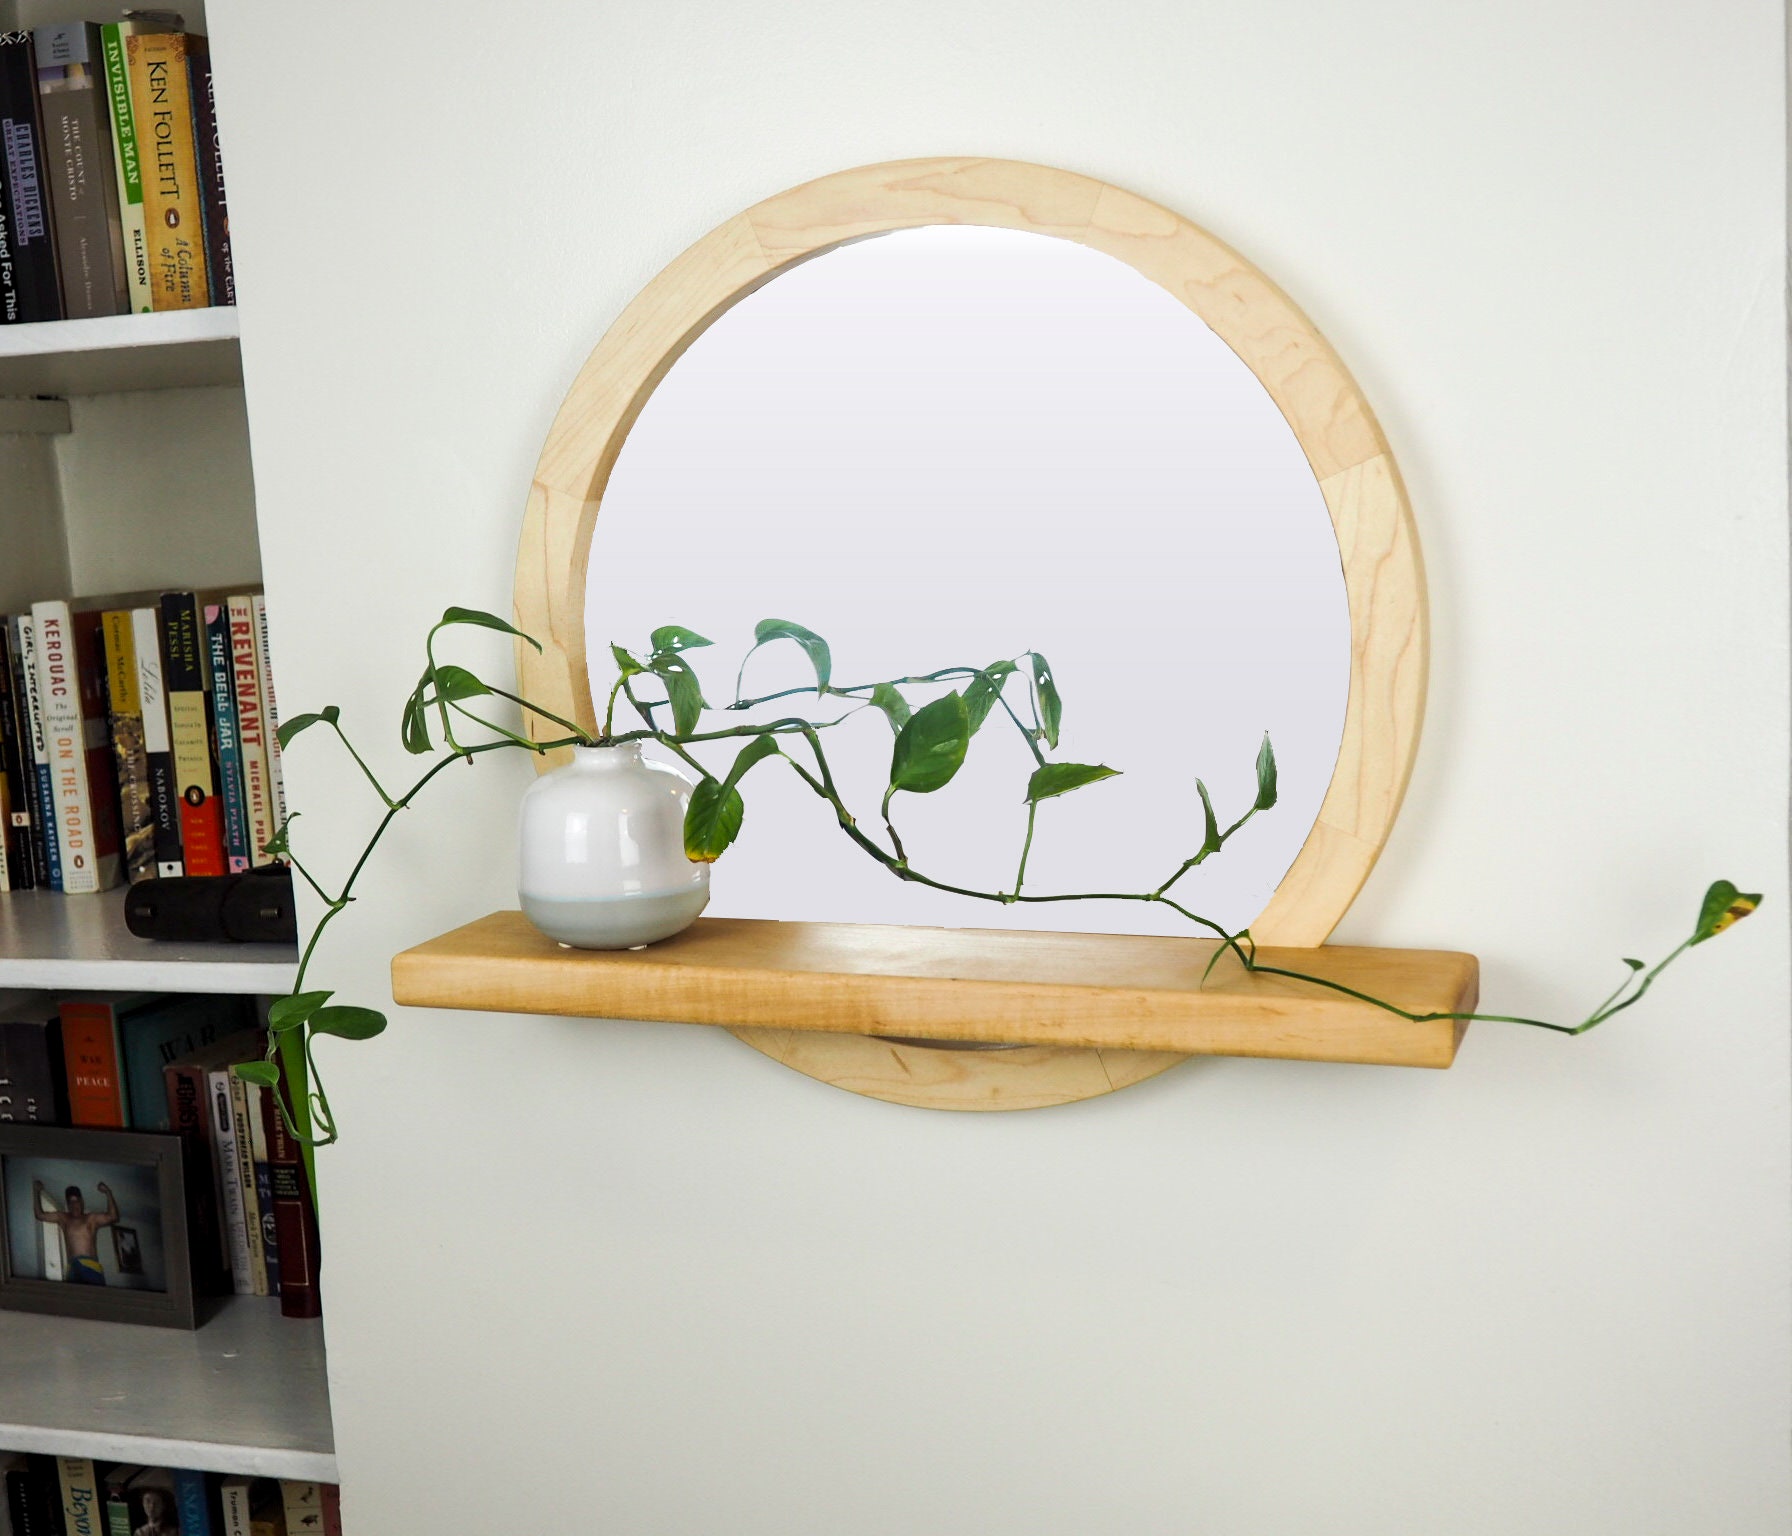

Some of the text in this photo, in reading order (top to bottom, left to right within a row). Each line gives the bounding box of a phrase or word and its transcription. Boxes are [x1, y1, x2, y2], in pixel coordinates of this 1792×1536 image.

[107, 42, 139, 184] INVISIBLE MAN
[147, 61, 168, 103] KEN
[62, 115, 77, 200] MONTE CRISTO
[71, 118, 80, 142] THE
[154, 111, 180, 200] FOLLETT
[4, 120, 27, 244] GREAT EXPECTATIONS
[16, 125, 43, 236] CHARLES DICKENS
[75, 145, 85, 184] COUNT
[0, 213, 17, 321] Asked For This
[133, 229, 147, 287] ELLISON
[161, 248, 178, 292] of Fire
[177, 250, 193, 304] Column
[23, 626, 33, 660] GIRL,
[181, 609, 195, 672] MARISHA
[230, 608, 248, 617] THE
[44, 619, 67, 697] KEROUAC
[230, 621, 261, 747] REVENANT
[27, 663, 45, 752] INTERRUPTED
[46, 714, 77, 722] Original
[211, 633, 233, 750] THE BELL JAR
[39, 768, 60, 862] SUSANNA KAYSEN
[57, 737, 84, 849] ON THE ROAD
[129, 775, 141, 833] CROSSING
[155, 768, 172, 831] NABOKOV
[225, 761, 241, 846] SYLVIA PLATH
[249, 760, 263, 814] MICHAEL
[76, 1076, 111, 1088] PEACE
[222, 1140, 235, 1173] MARK
[229, 1491, 240, 1527] Truman
